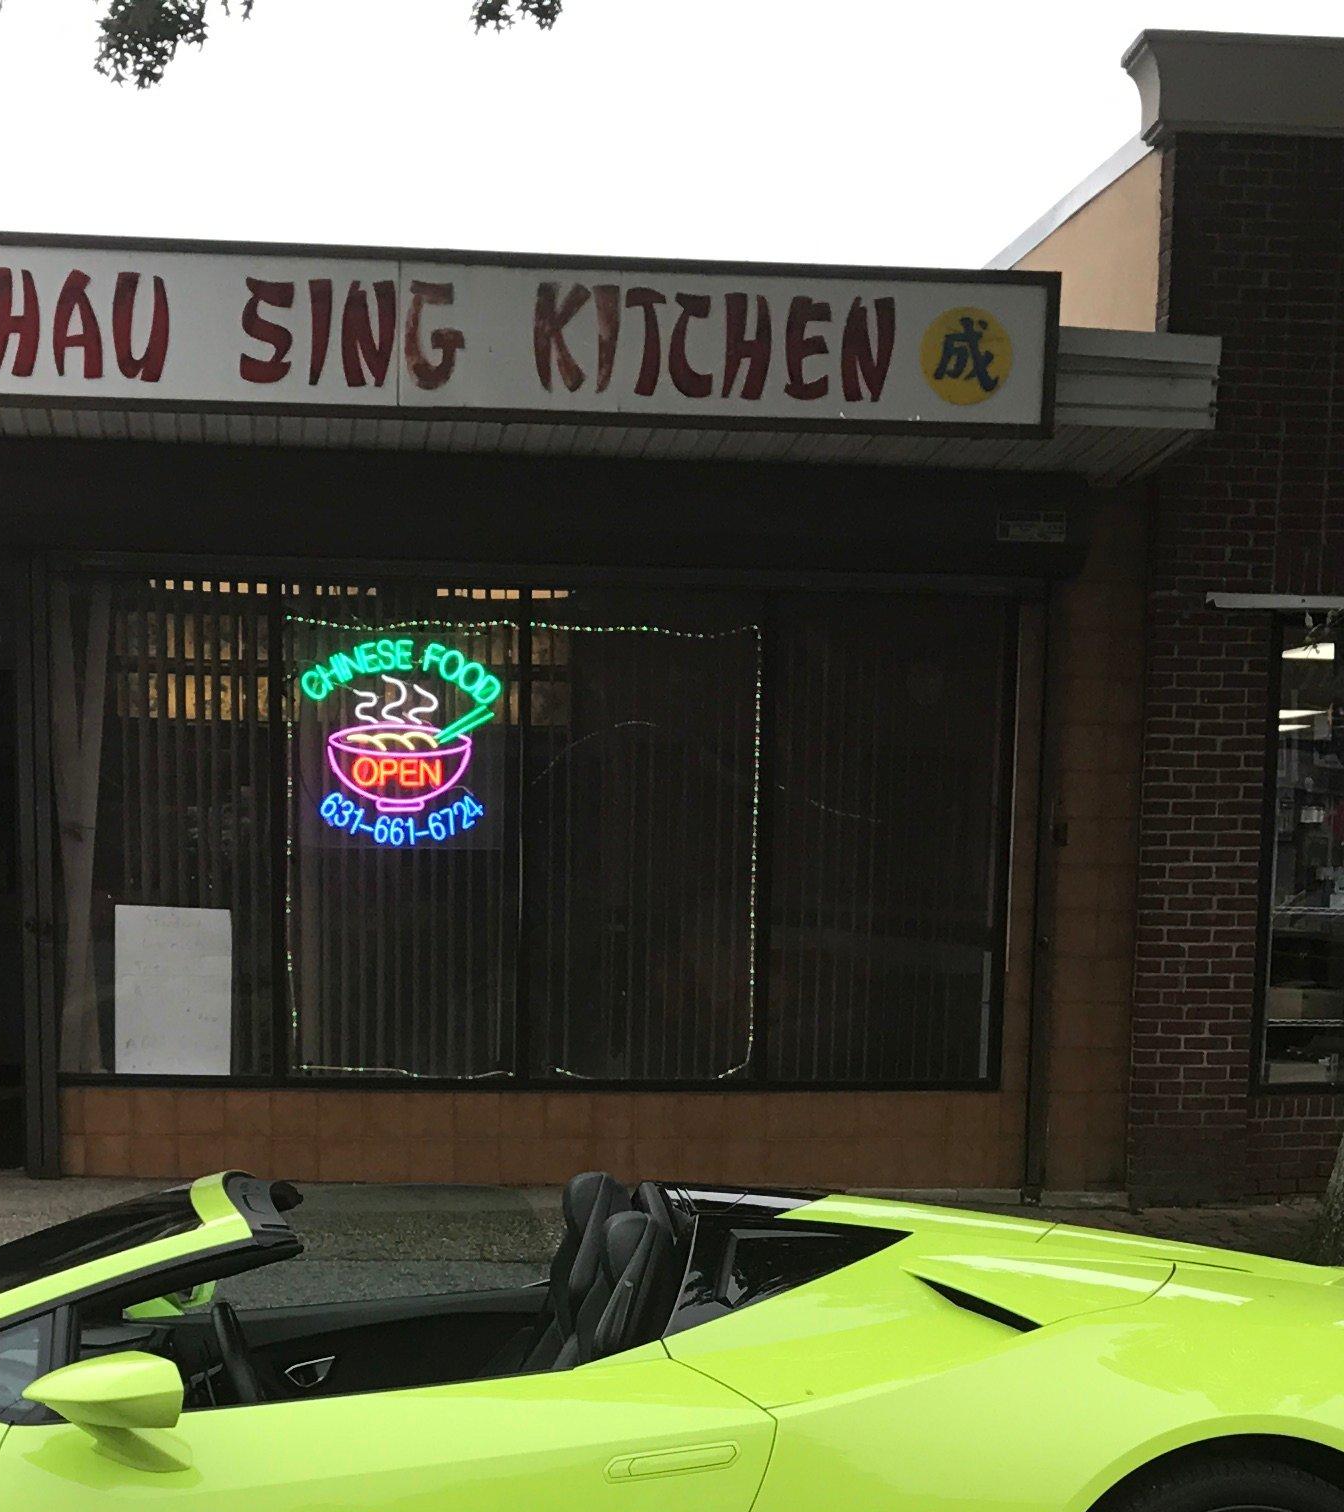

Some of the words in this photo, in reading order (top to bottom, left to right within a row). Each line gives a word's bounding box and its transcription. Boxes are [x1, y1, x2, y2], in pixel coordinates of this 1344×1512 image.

[239, 277, 465, 391] SING
[533, 281, 896, 403] KITCHEN
[933, 316, 1000, 393] 成
[300, 639, 414, 700] CHINESE
[421, 642, 503, 705] FOOD
[351, 756, 443, 787] OPEN
[319, 791, 485, 847] 631-661-6724
